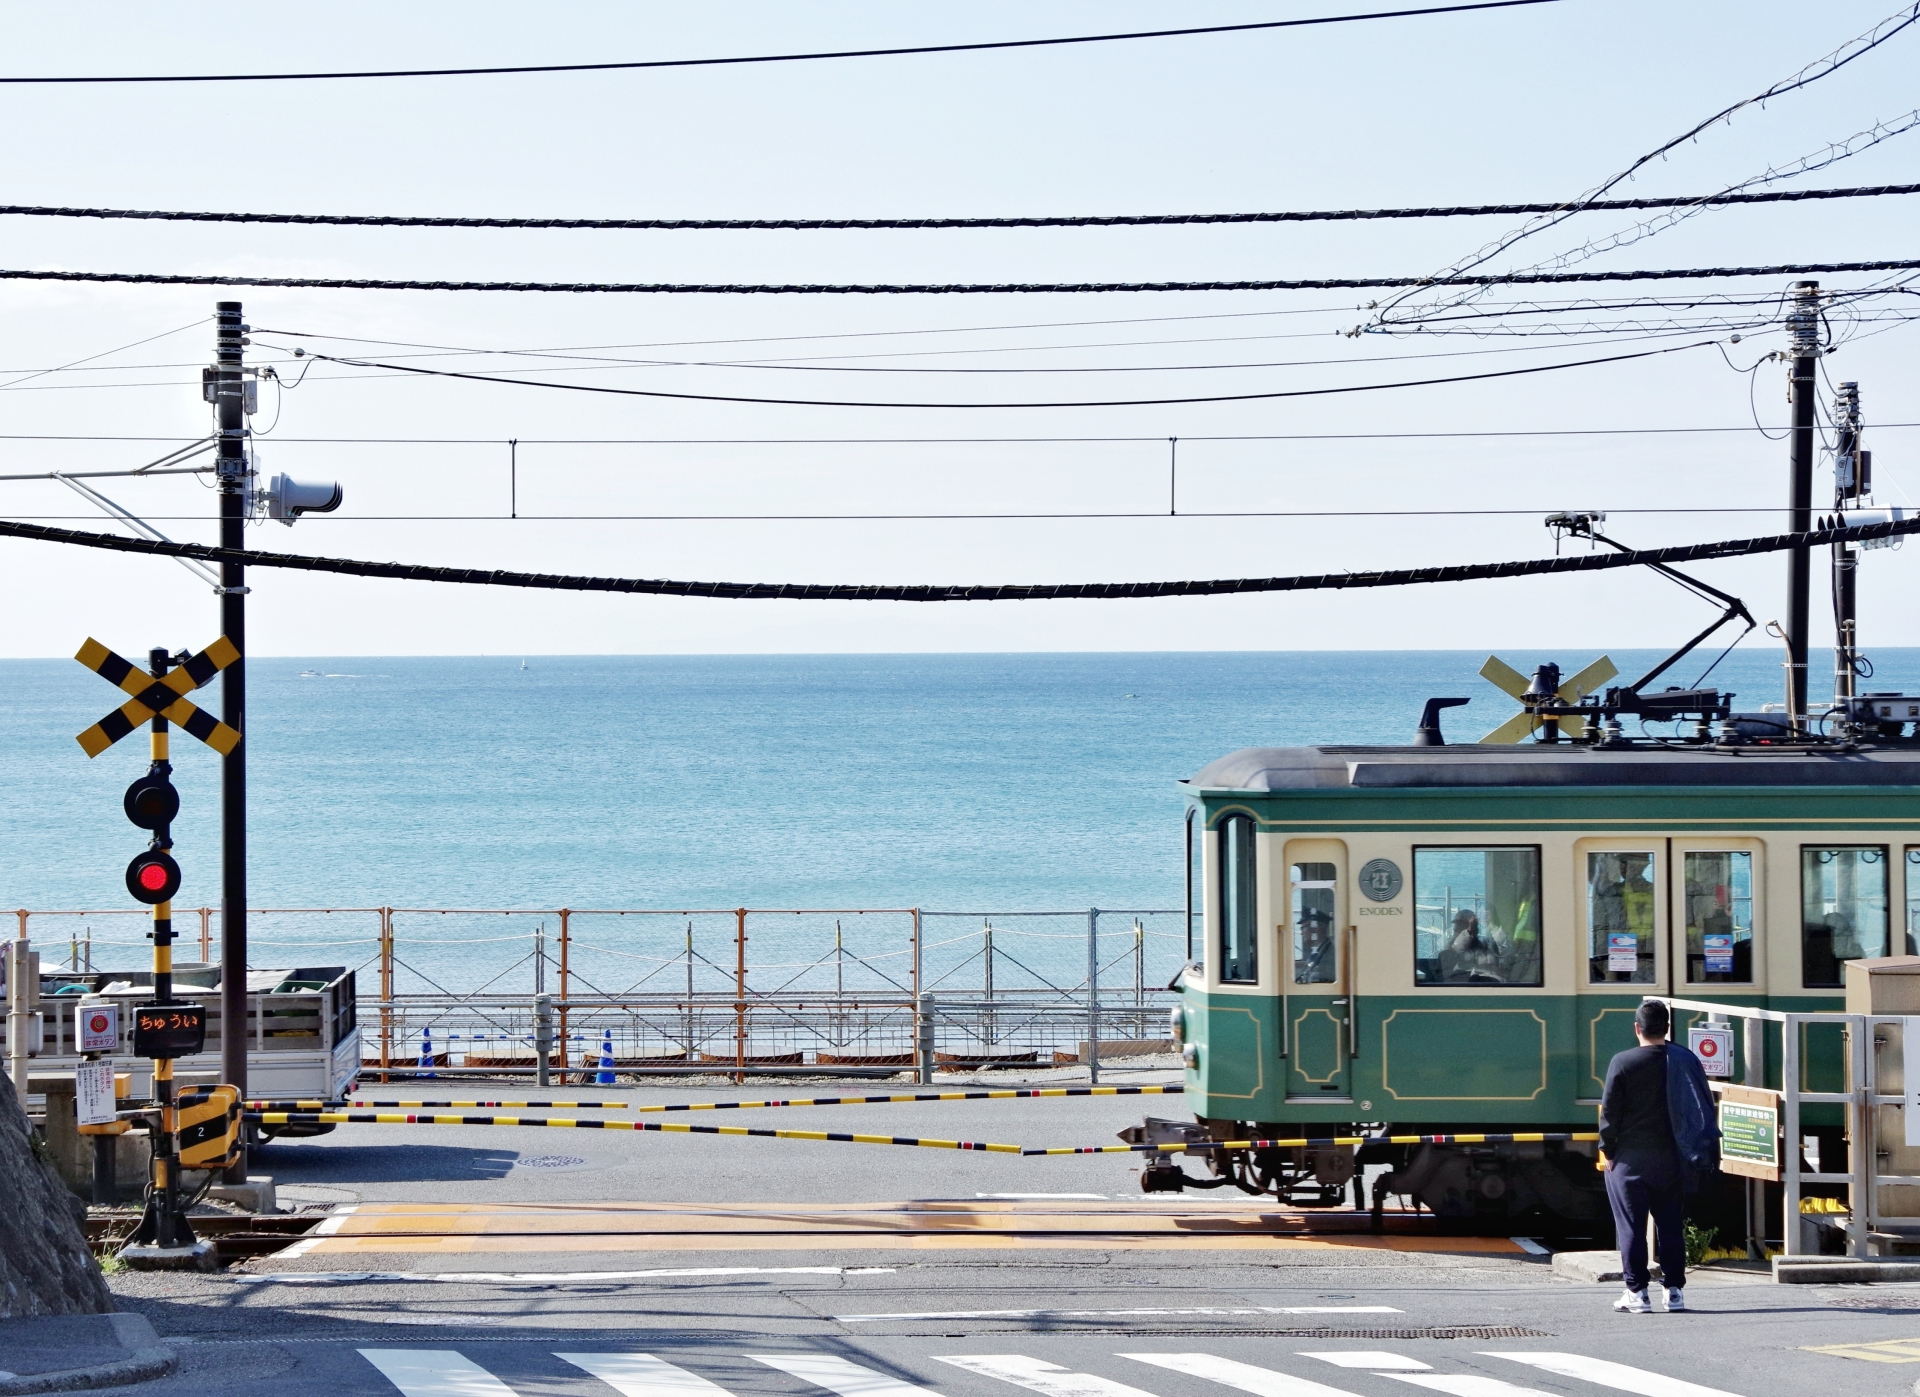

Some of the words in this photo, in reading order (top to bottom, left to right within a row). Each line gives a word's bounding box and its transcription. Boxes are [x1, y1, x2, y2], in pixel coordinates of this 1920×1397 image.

[1359, 907, 1404, 916] ENODEN
[140, 1014, 198, 1030] ちゅうい
[85, 1038, 115, 1047] 非常ボタン
[1702, 1063, 1724, 1072] 常ボタン
[198, 1126, 205, 1137] 2
